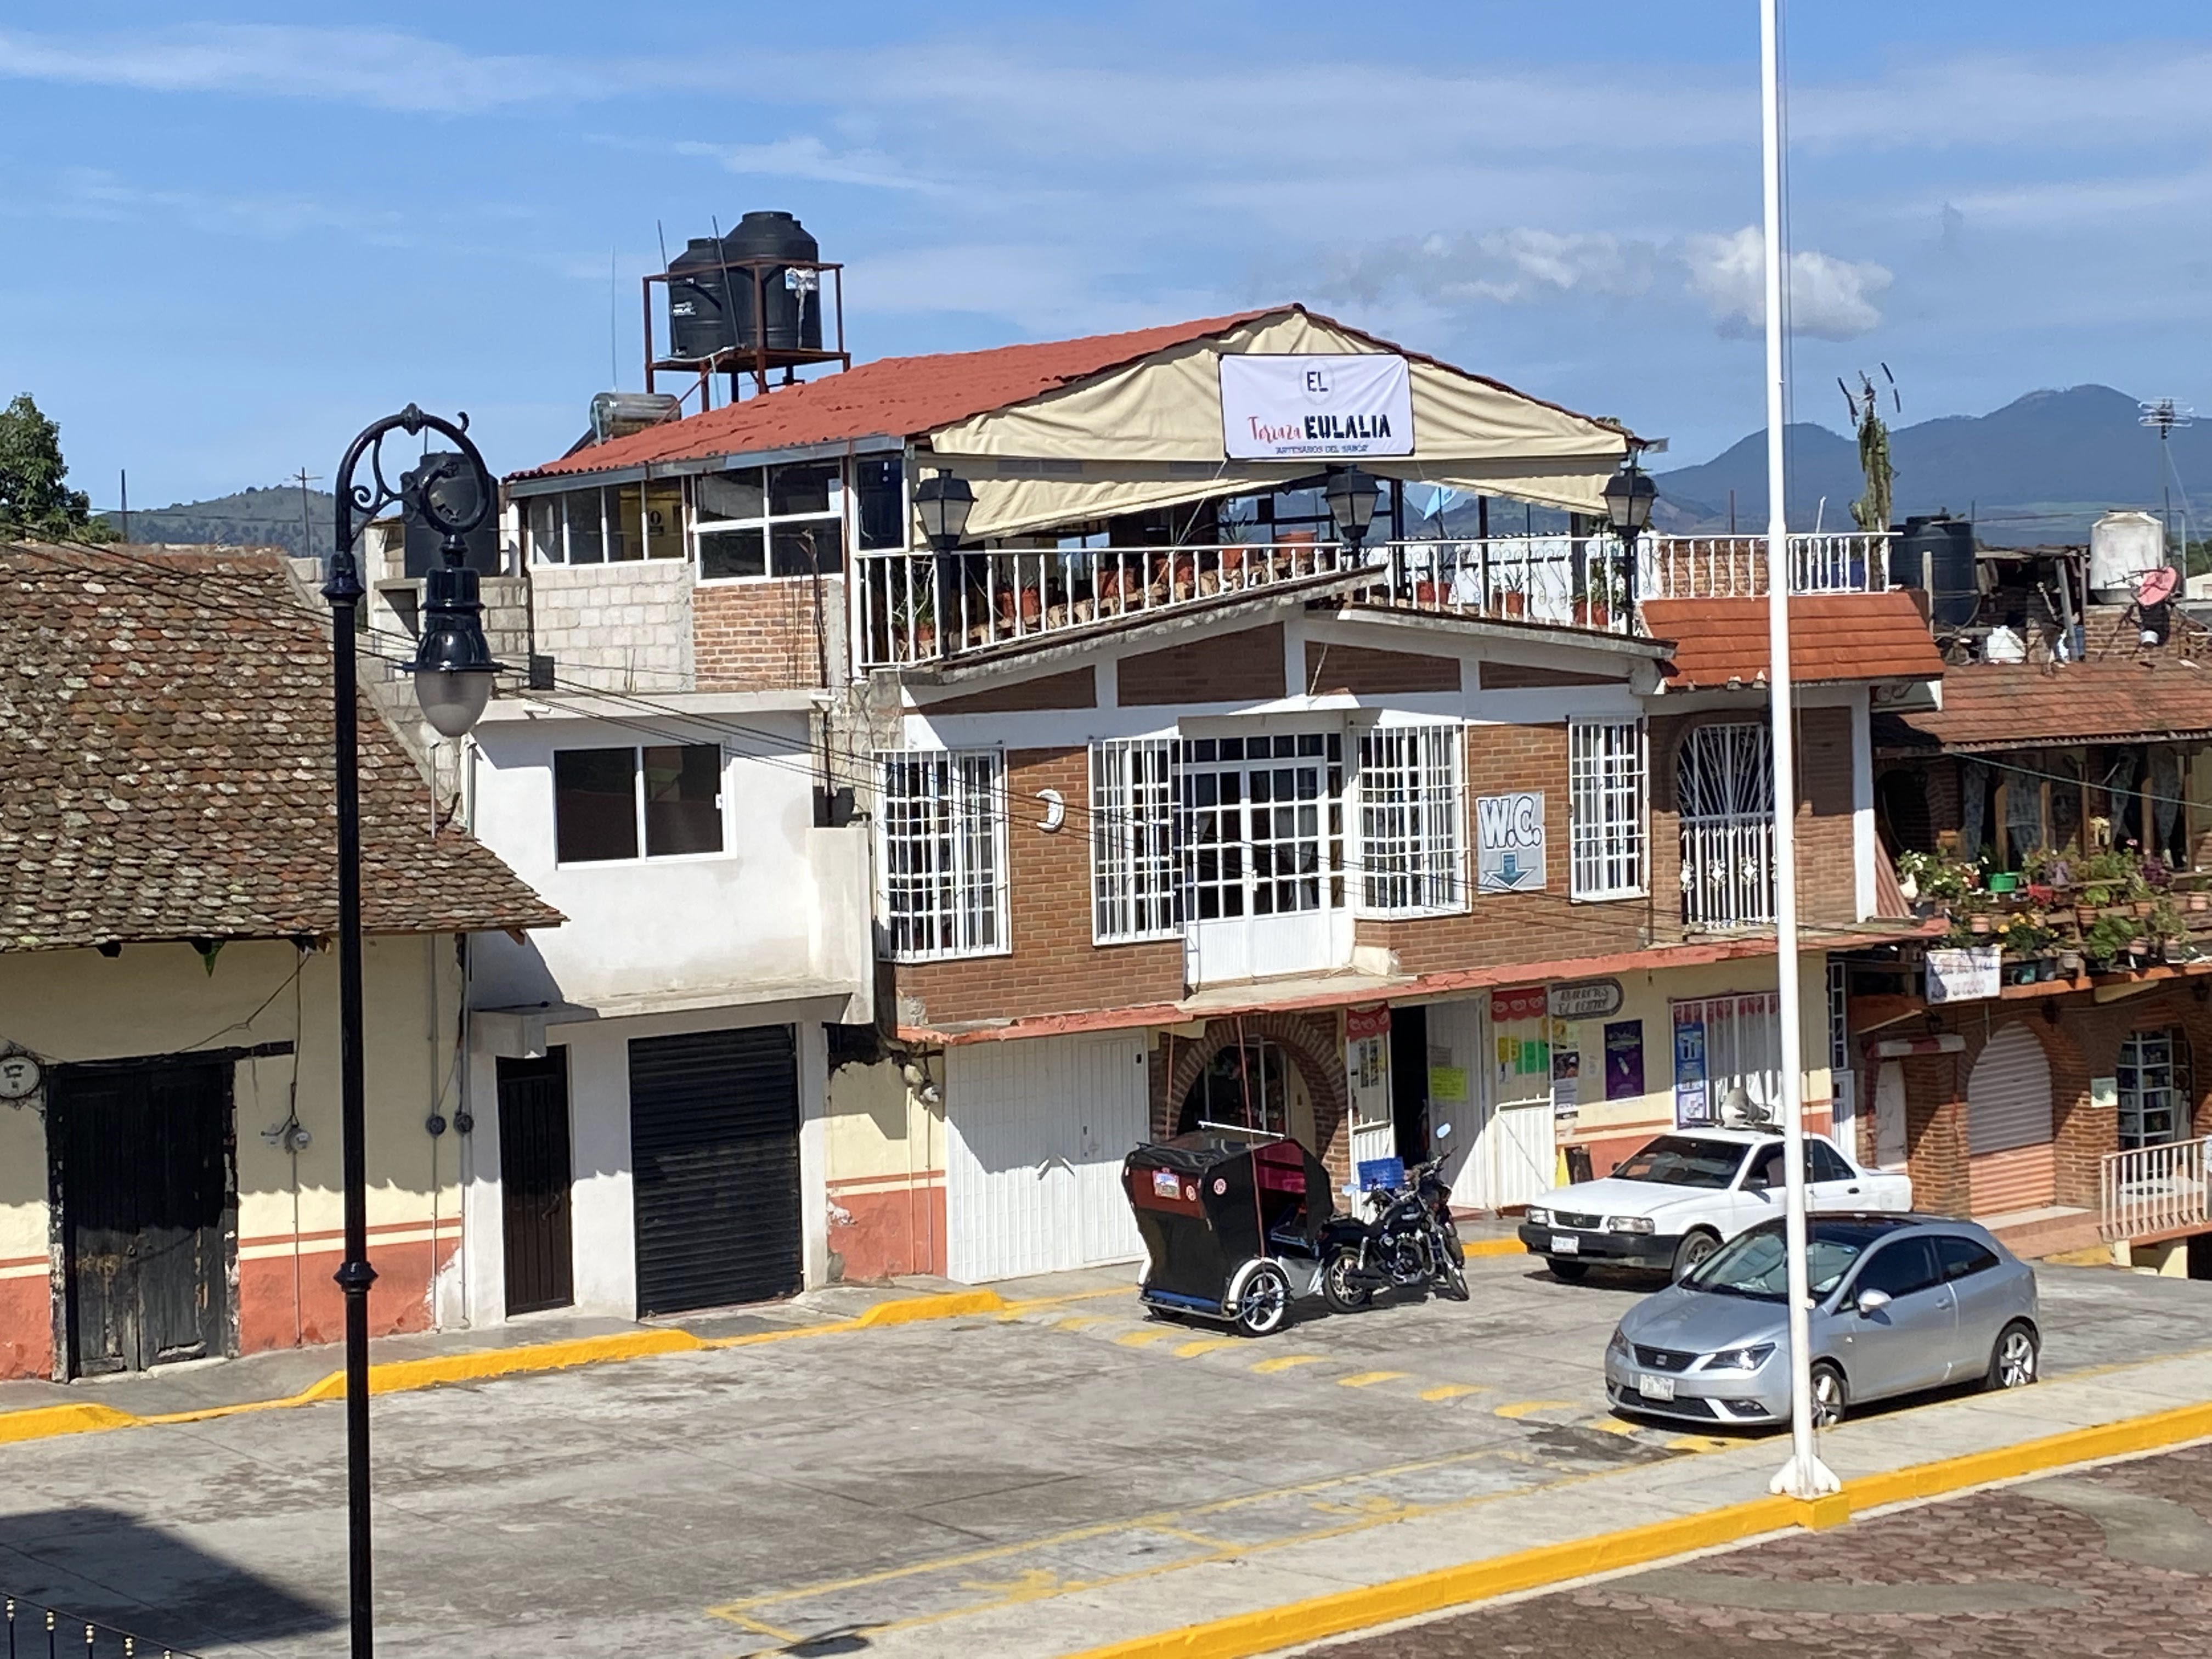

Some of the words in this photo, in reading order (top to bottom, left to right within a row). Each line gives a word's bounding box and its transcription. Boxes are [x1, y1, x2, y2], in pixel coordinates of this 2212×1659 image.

[1307, 371, 1329, 392] EL
[1248, 415, 1302, 443] Terraza
[1304, 414, 1392, 439] EULALIA
[1325, 445, 1339, 453] DEL
[1478, 796, 1542, 849] W.C.
